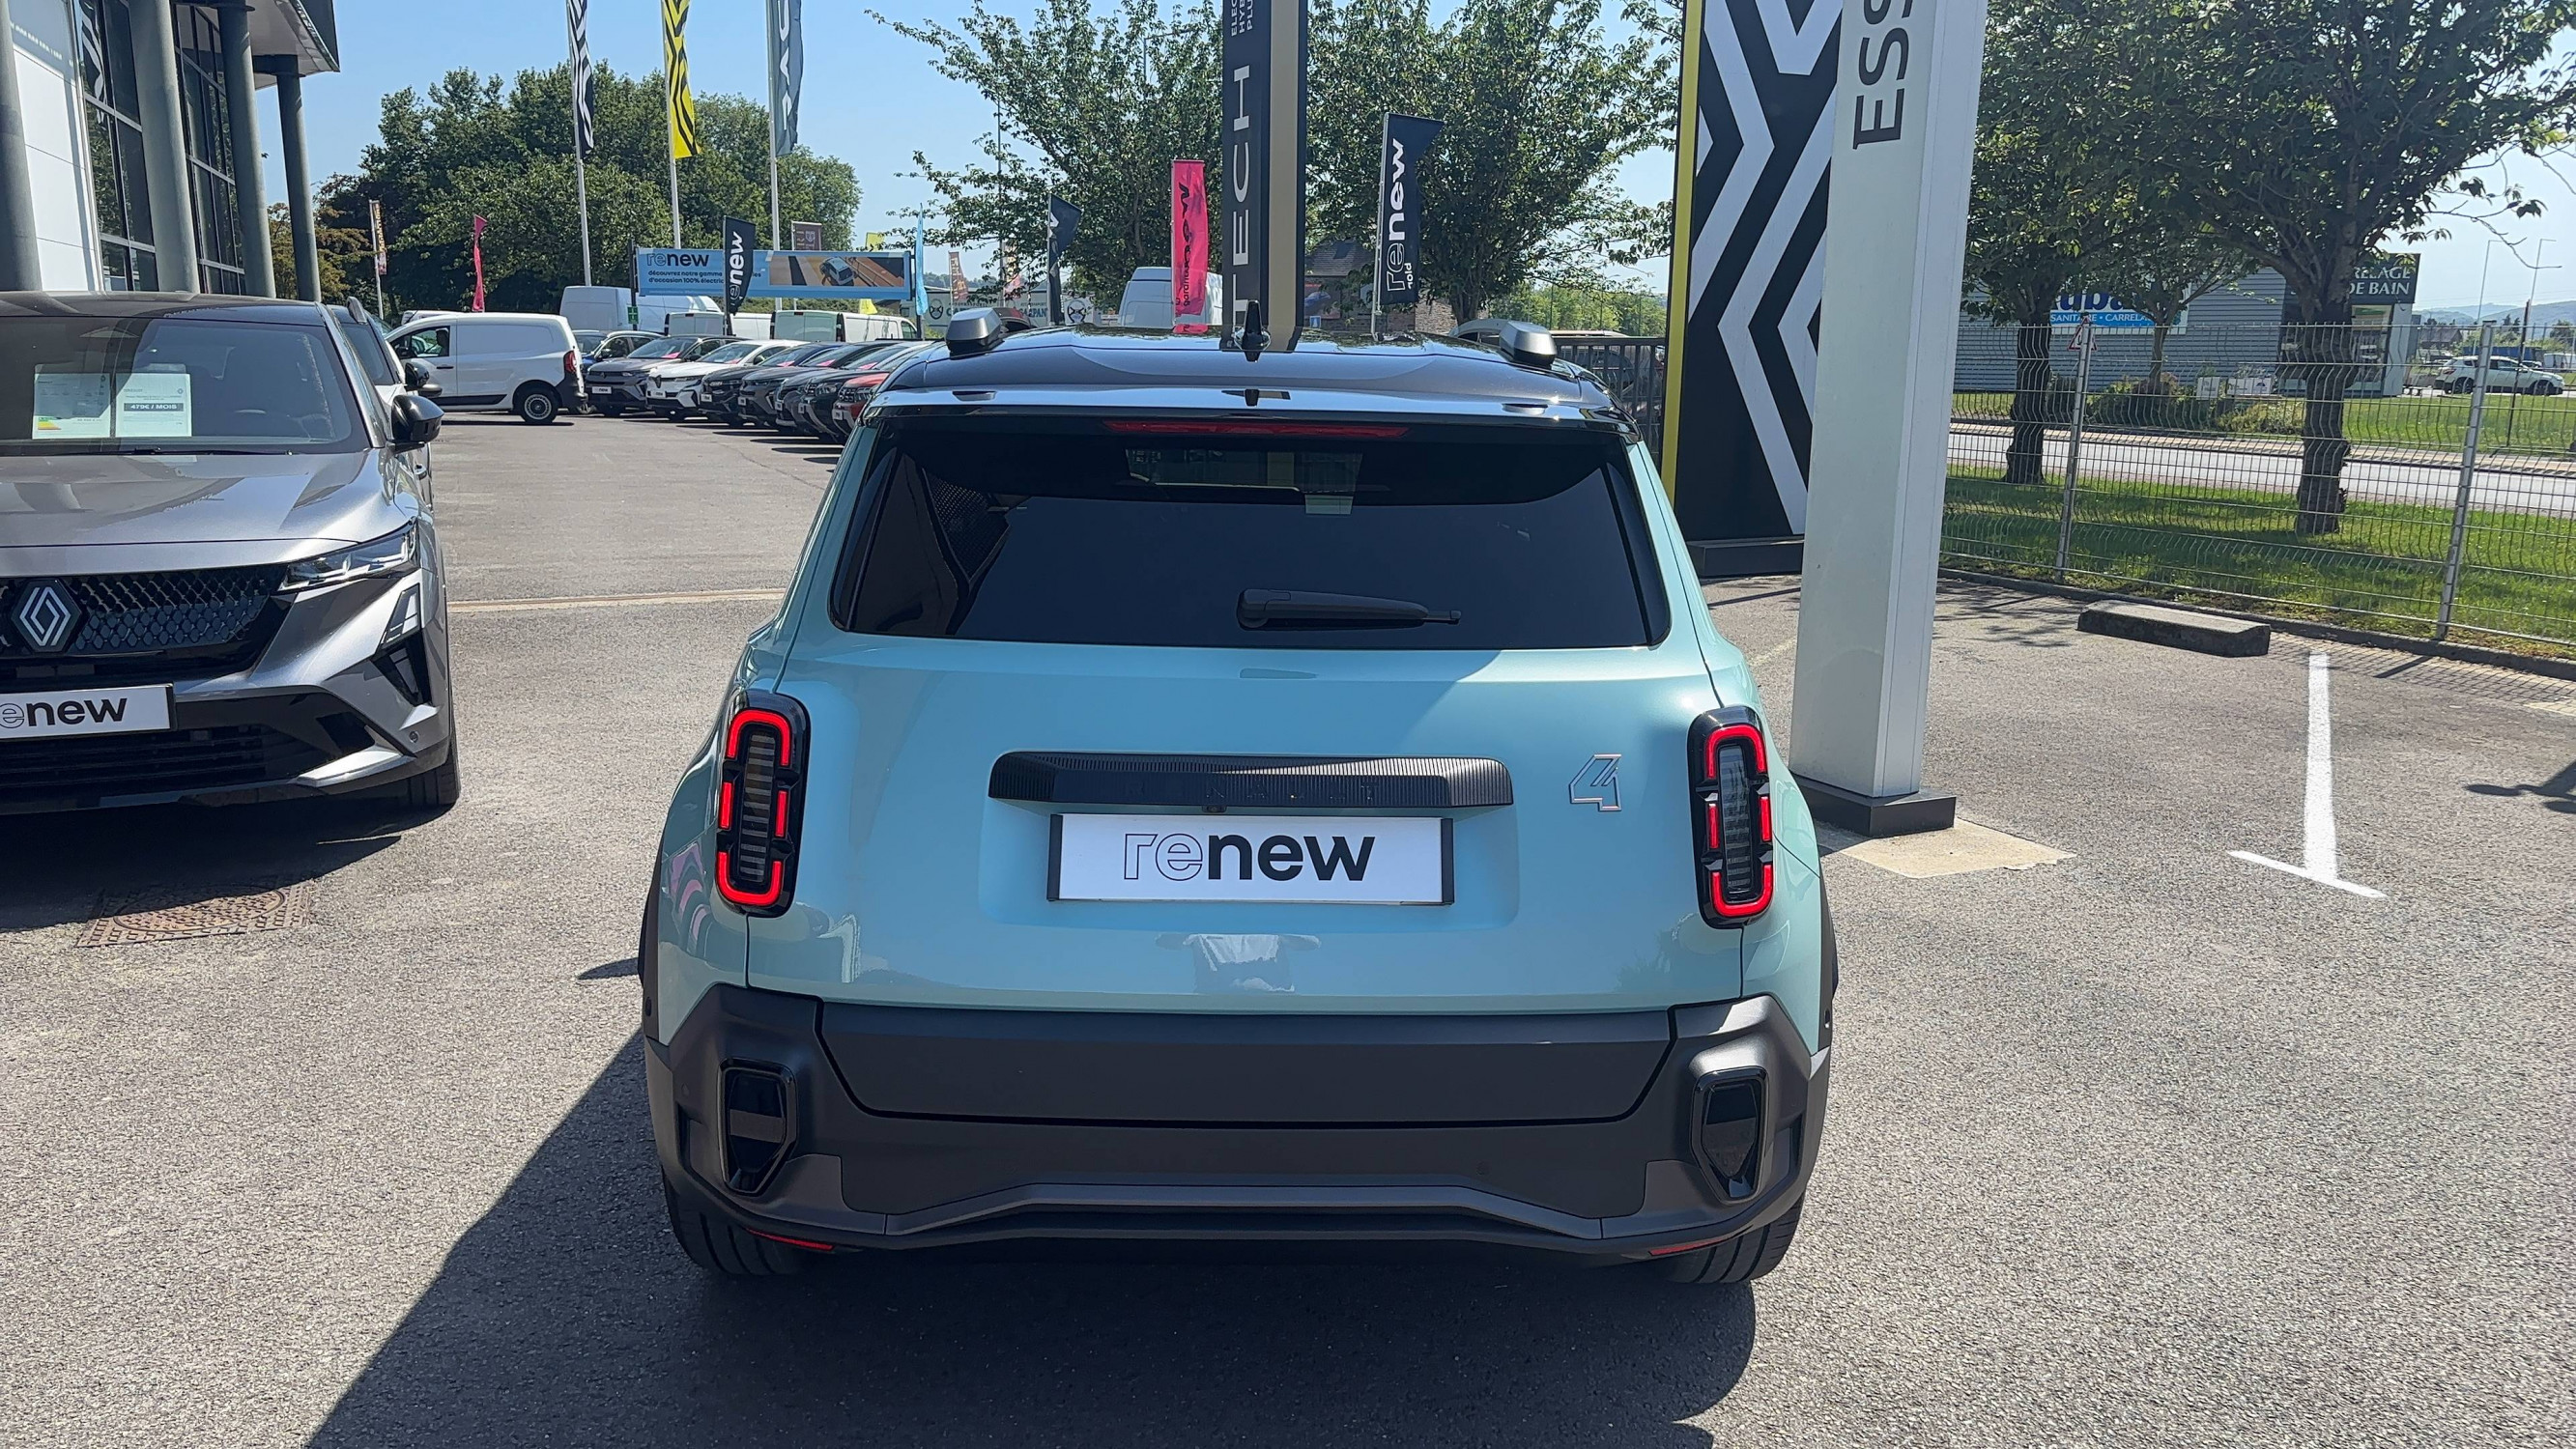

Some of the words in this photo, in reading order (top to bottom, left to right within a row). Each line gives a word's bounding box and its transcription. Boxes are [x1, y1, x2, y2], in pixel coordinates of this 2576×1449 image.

[1387, 138, 1406, 292] renew
[646, 253, 709, 267] renew
[2368, 281, 2410, 295] BAIN
[2050, 313, 2097, 323] SANITRE
[0, 697, 128, 729] enew
[1568, 753, 1622, 811] 4
[1124, 833, 1375, 881] renew
